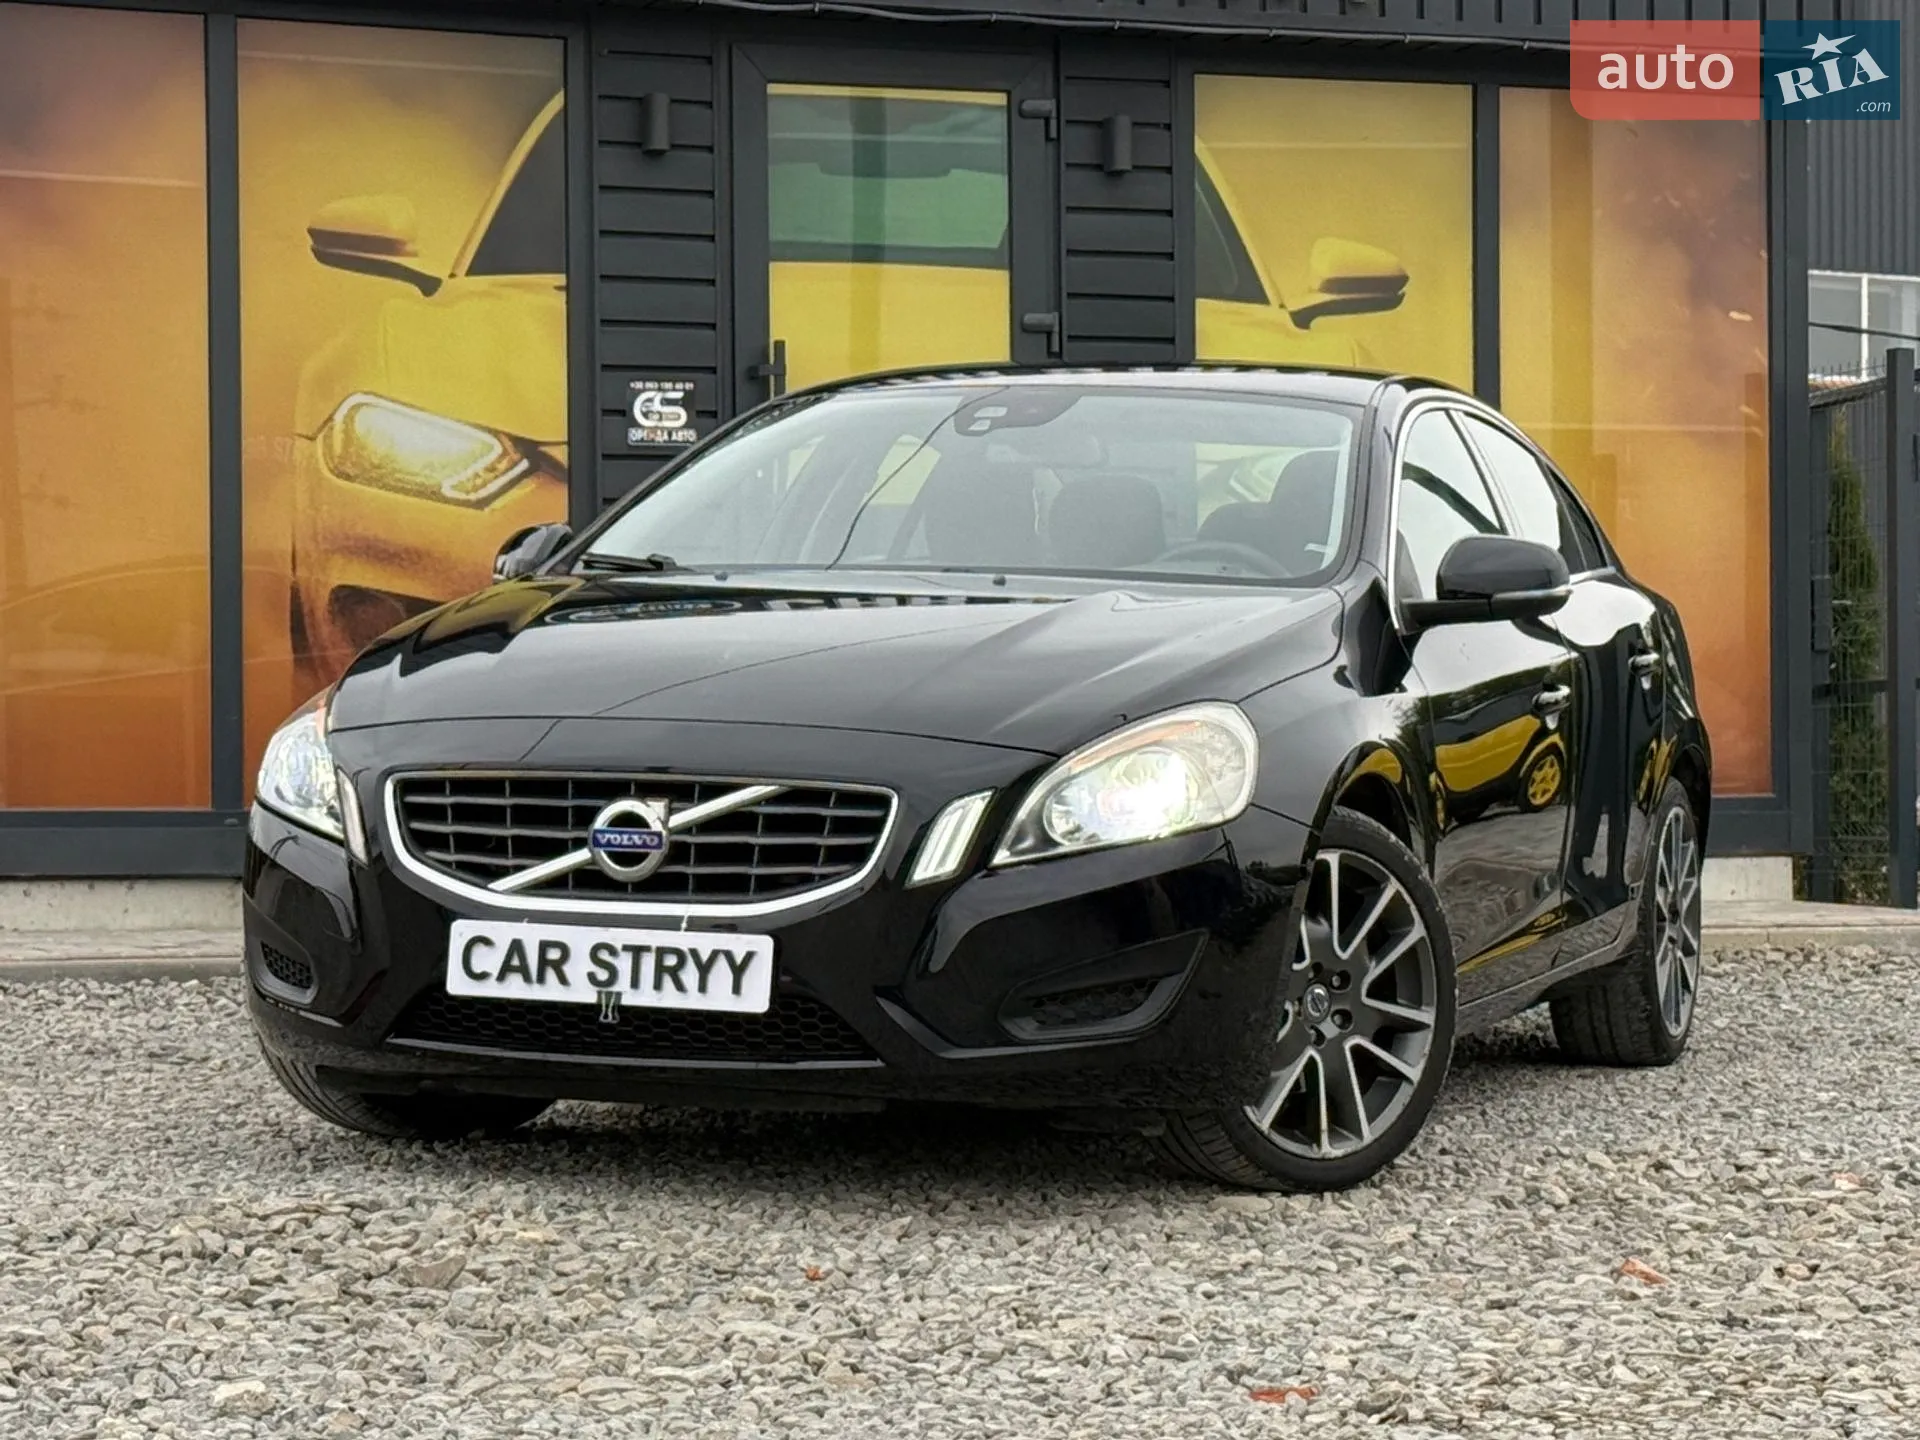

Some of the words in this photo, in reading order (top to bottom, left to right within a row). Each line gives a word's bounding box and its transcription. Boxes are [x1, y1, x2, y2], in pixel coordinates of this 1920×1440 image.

[629, 428, 669, 442] ОРЕНДА
[671, 429, 697, 442] АВТО
[594, 832, 659, 846] VOLVO
[461, 935, 572, 988] CAR
[586, 941, 757, 997] STRYY
